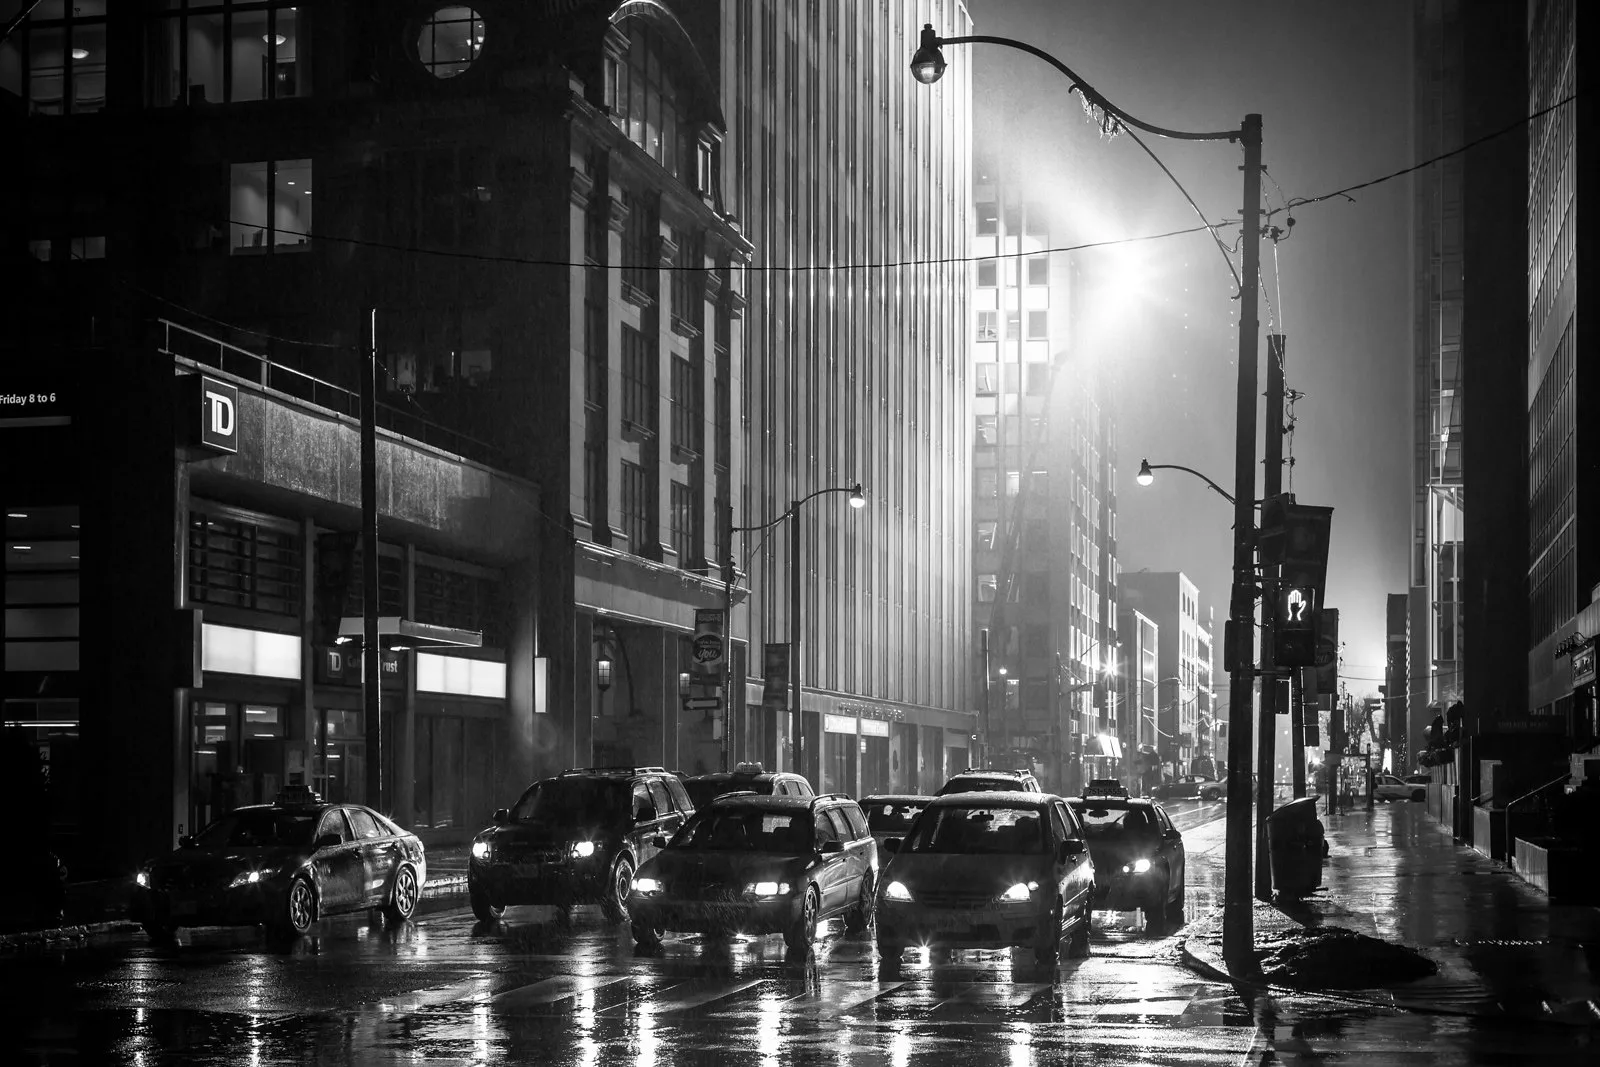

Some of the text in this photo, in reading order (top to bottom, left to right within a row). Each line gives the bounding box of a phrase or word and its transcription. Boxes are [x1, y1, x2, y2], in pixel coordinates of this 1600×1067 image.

[0, 392, 57, 406] Friday 8 to 6
[206, 390, 234, 436] TD
[329, 651, 341, 672] TD
[382, 660, 398, 673] rust
